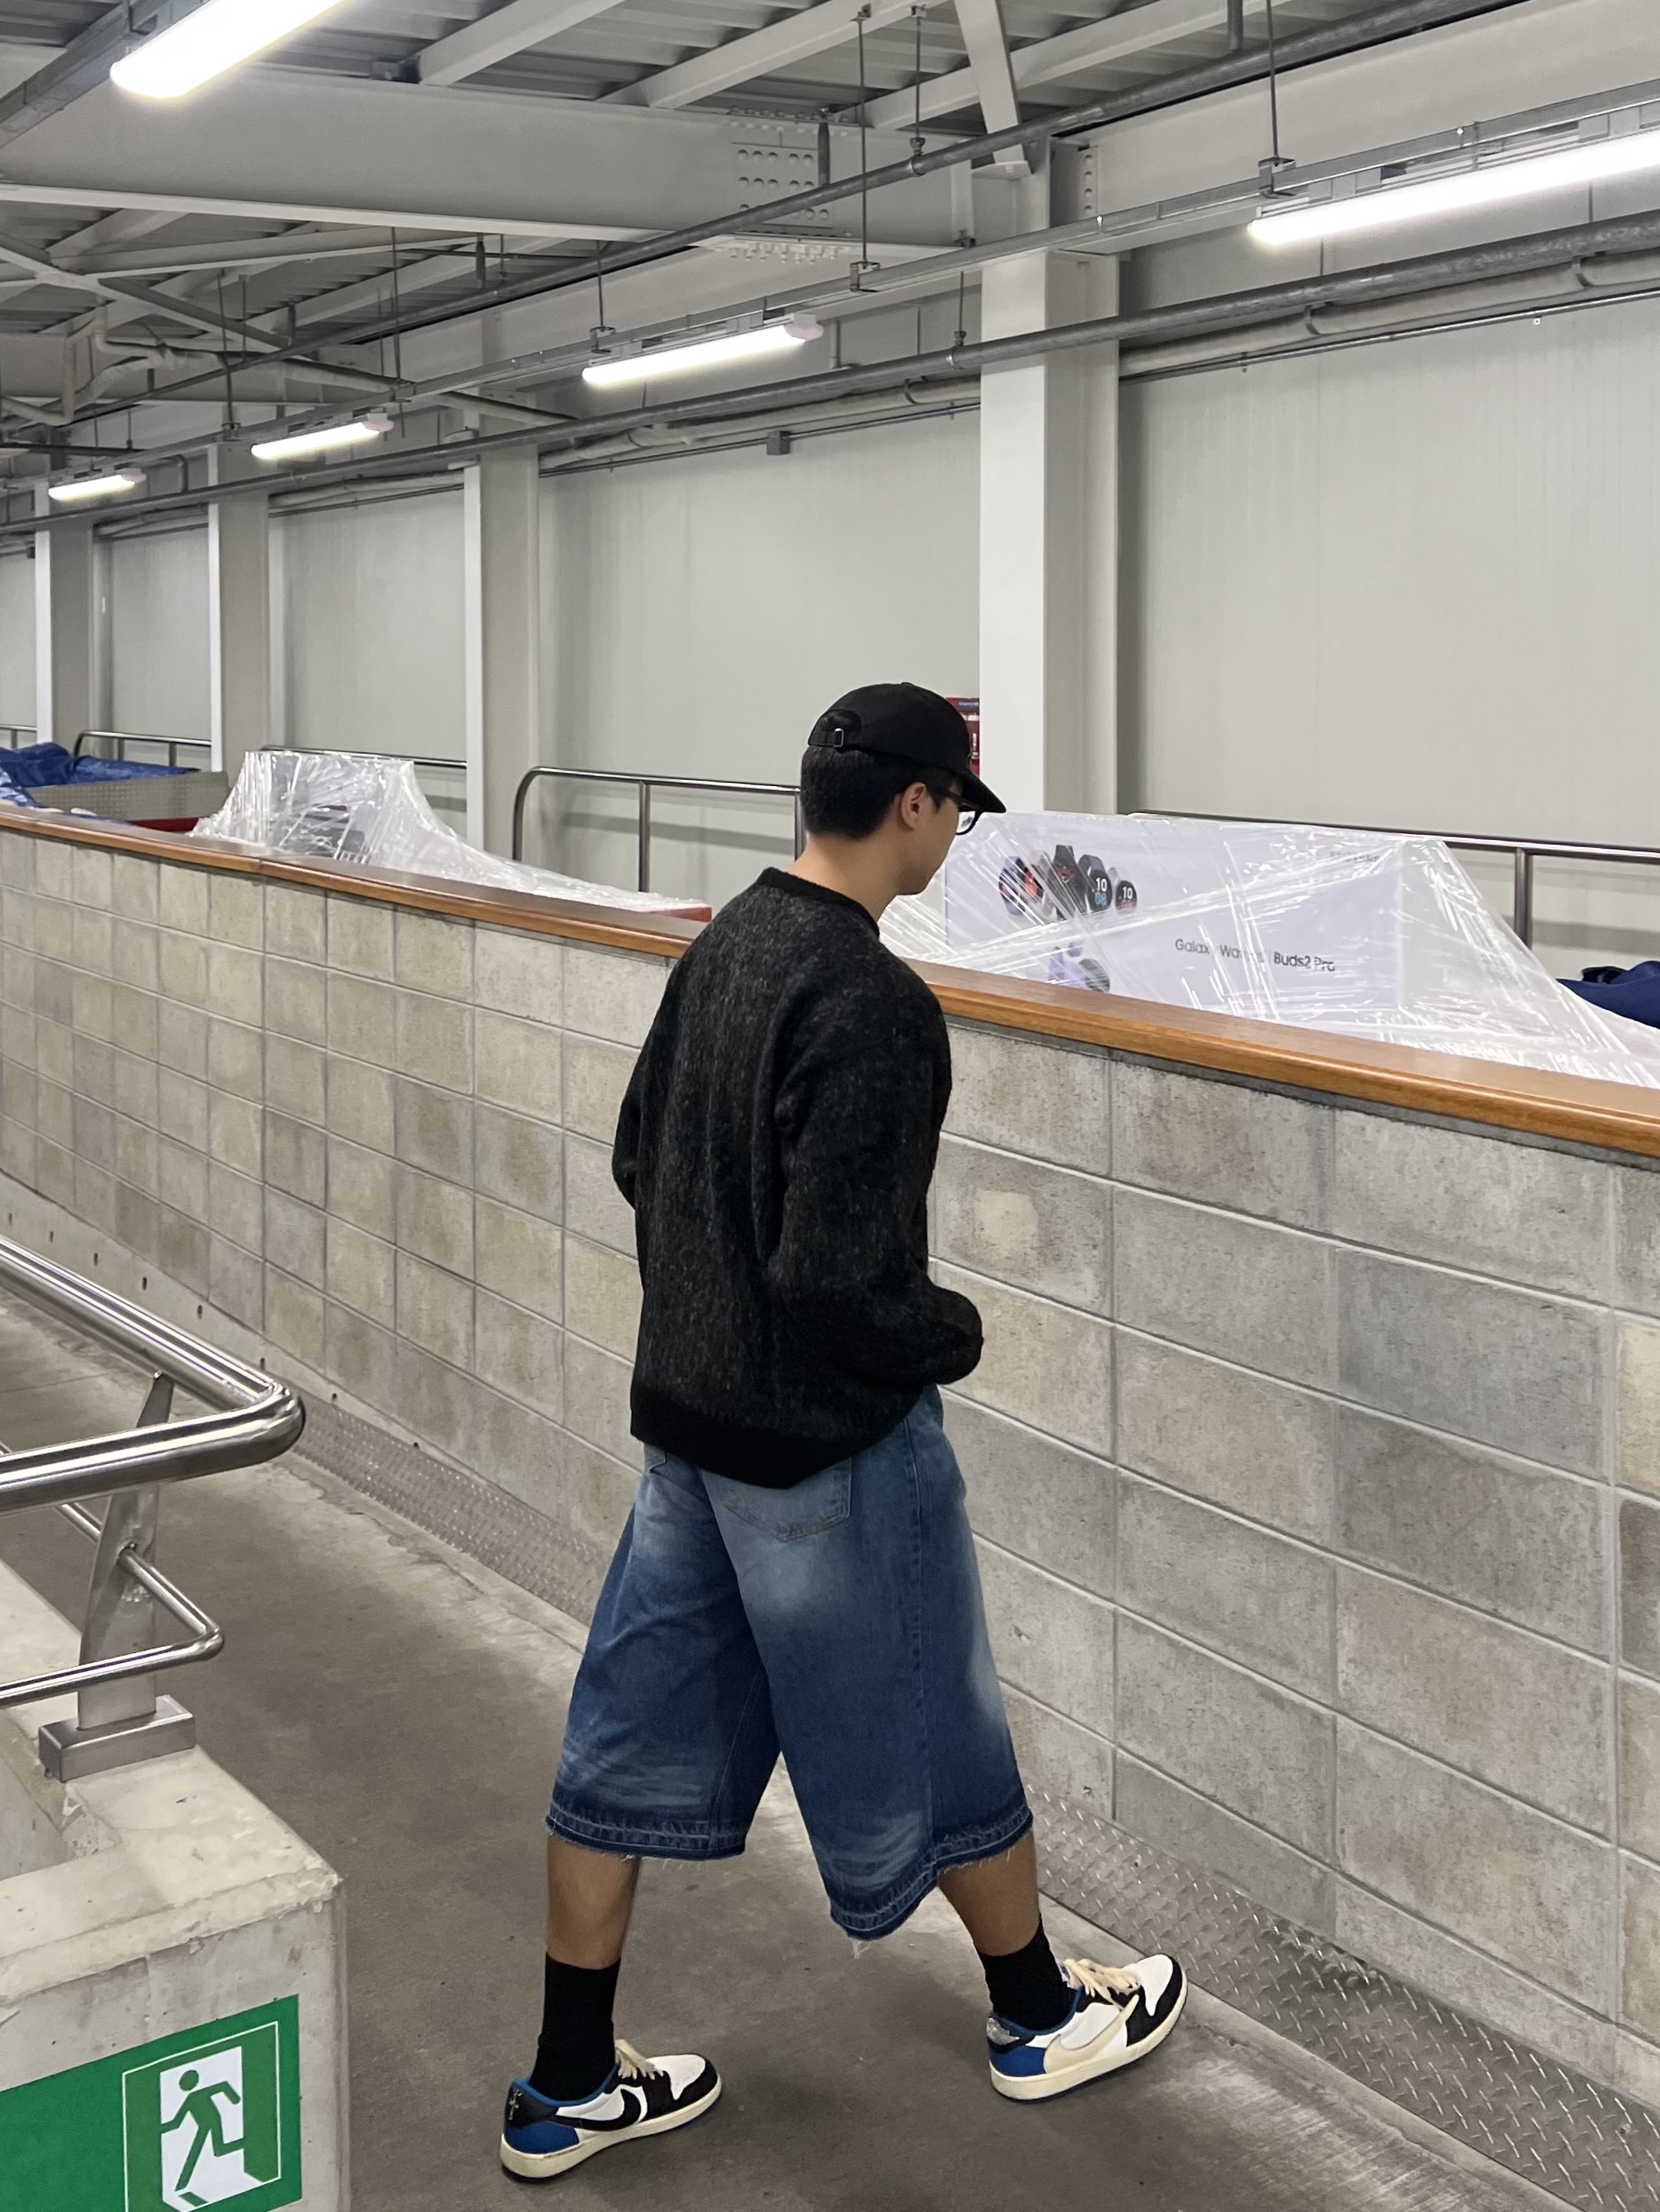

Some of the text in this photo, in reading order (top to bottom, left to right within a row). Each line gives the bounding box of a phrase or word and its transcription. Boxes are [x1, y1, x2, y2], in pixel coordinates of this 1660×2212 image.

[1096, 878, 1108, 892] 10
[1123, 886, 1133, 899] 10
[1175, 939, 1217, 956] Galax
